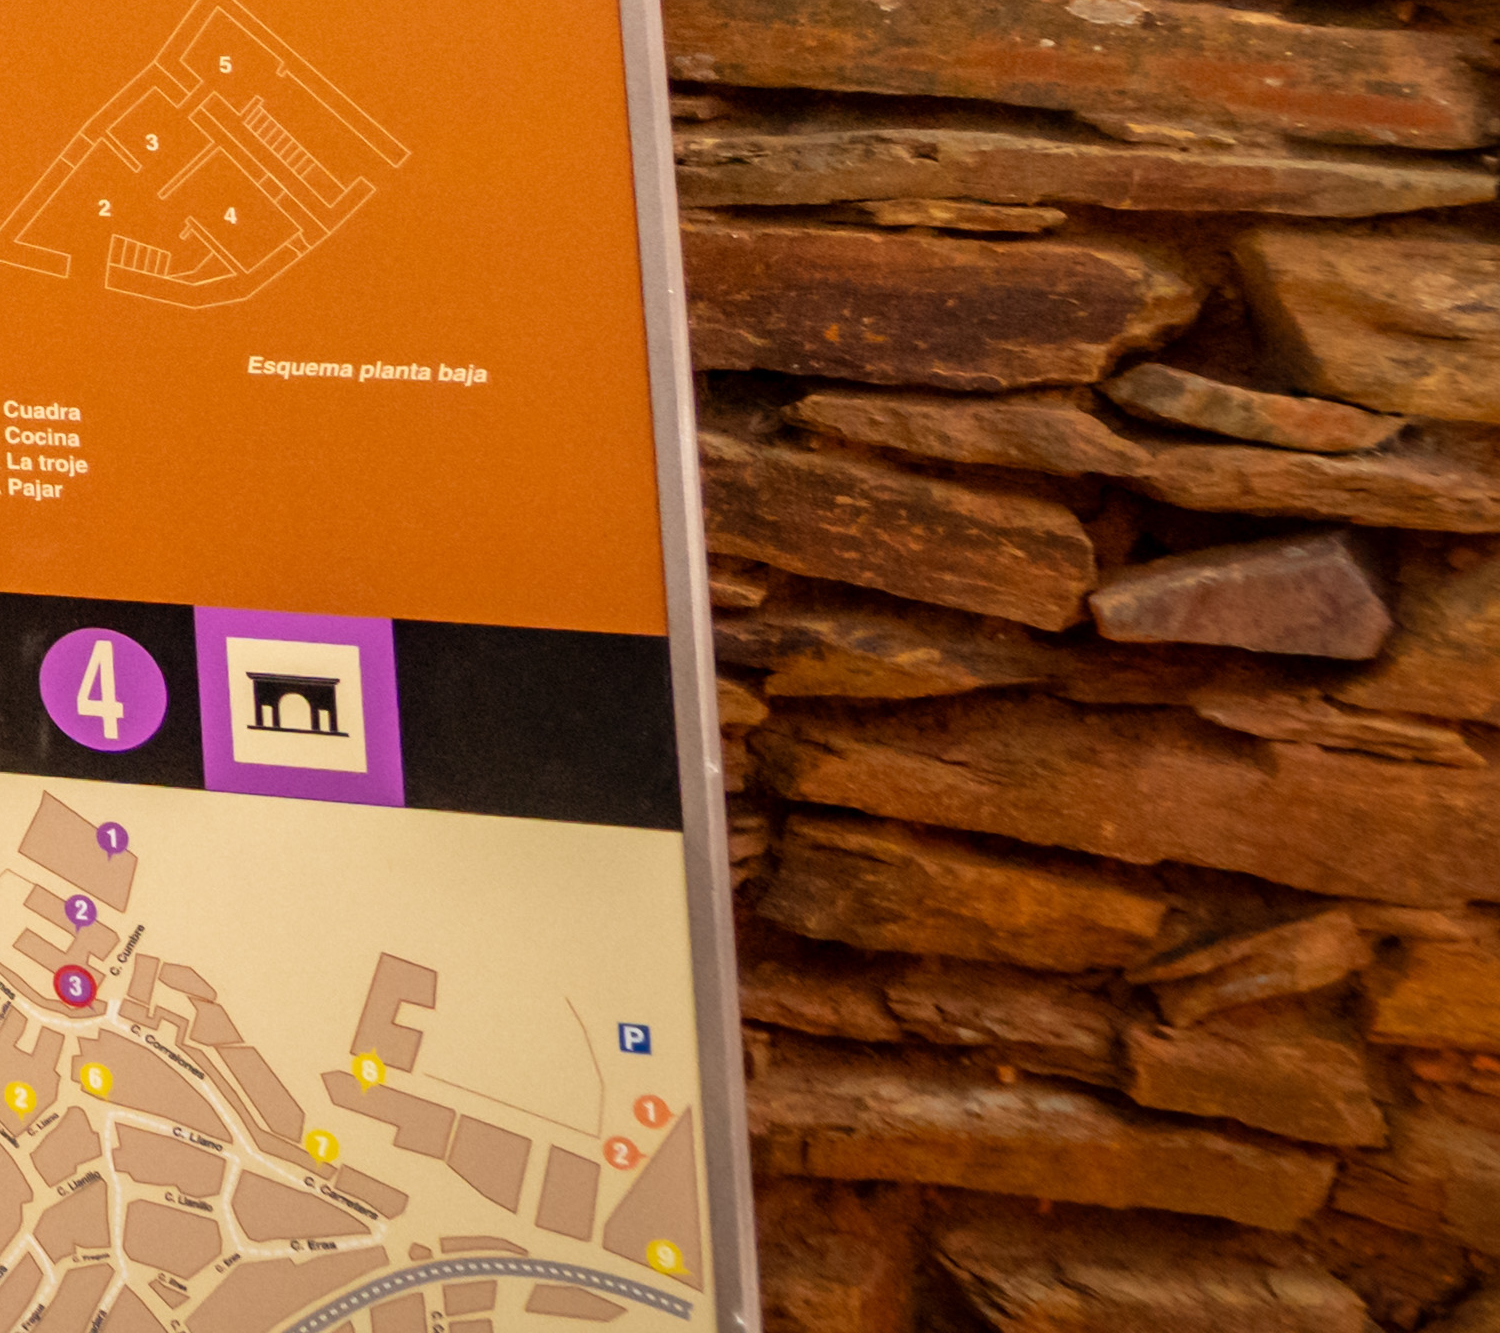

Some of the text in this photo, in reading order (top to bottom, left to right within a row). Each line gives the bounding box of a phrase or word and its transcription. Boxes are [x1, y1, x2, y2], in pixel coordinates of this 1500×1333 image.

[220, 56, 232, 73] 5
[146, 134, 158, 151] 3
[99, 200, 110, 216] 2
[224, 208, 237, 224] 4
[248, 357, 487, 386] Esquema planta baja
[4, 401, 81, 421] Cuadra
[5, 426, 80, 447] Cocina
[7, 453, 32, 470] La
[39, 456, 88, 477] troje
[8, 478, 62, 501] Pajar
[77, 641, 123, 739] 4
[107, 829, 116, 848] 1
[76, 900, 88, 920] 2
[117, 924, 145, 963] Cumbre
[70, 976, 82, 996] 3
[623, 1028, 644, 1051] P
[89, 1068, 102, 1089] 6
[15, 1087, 27, 1108] 2
[645, 1103, 655, 1121] 1
[615, 1143, 628, 1164] 2
